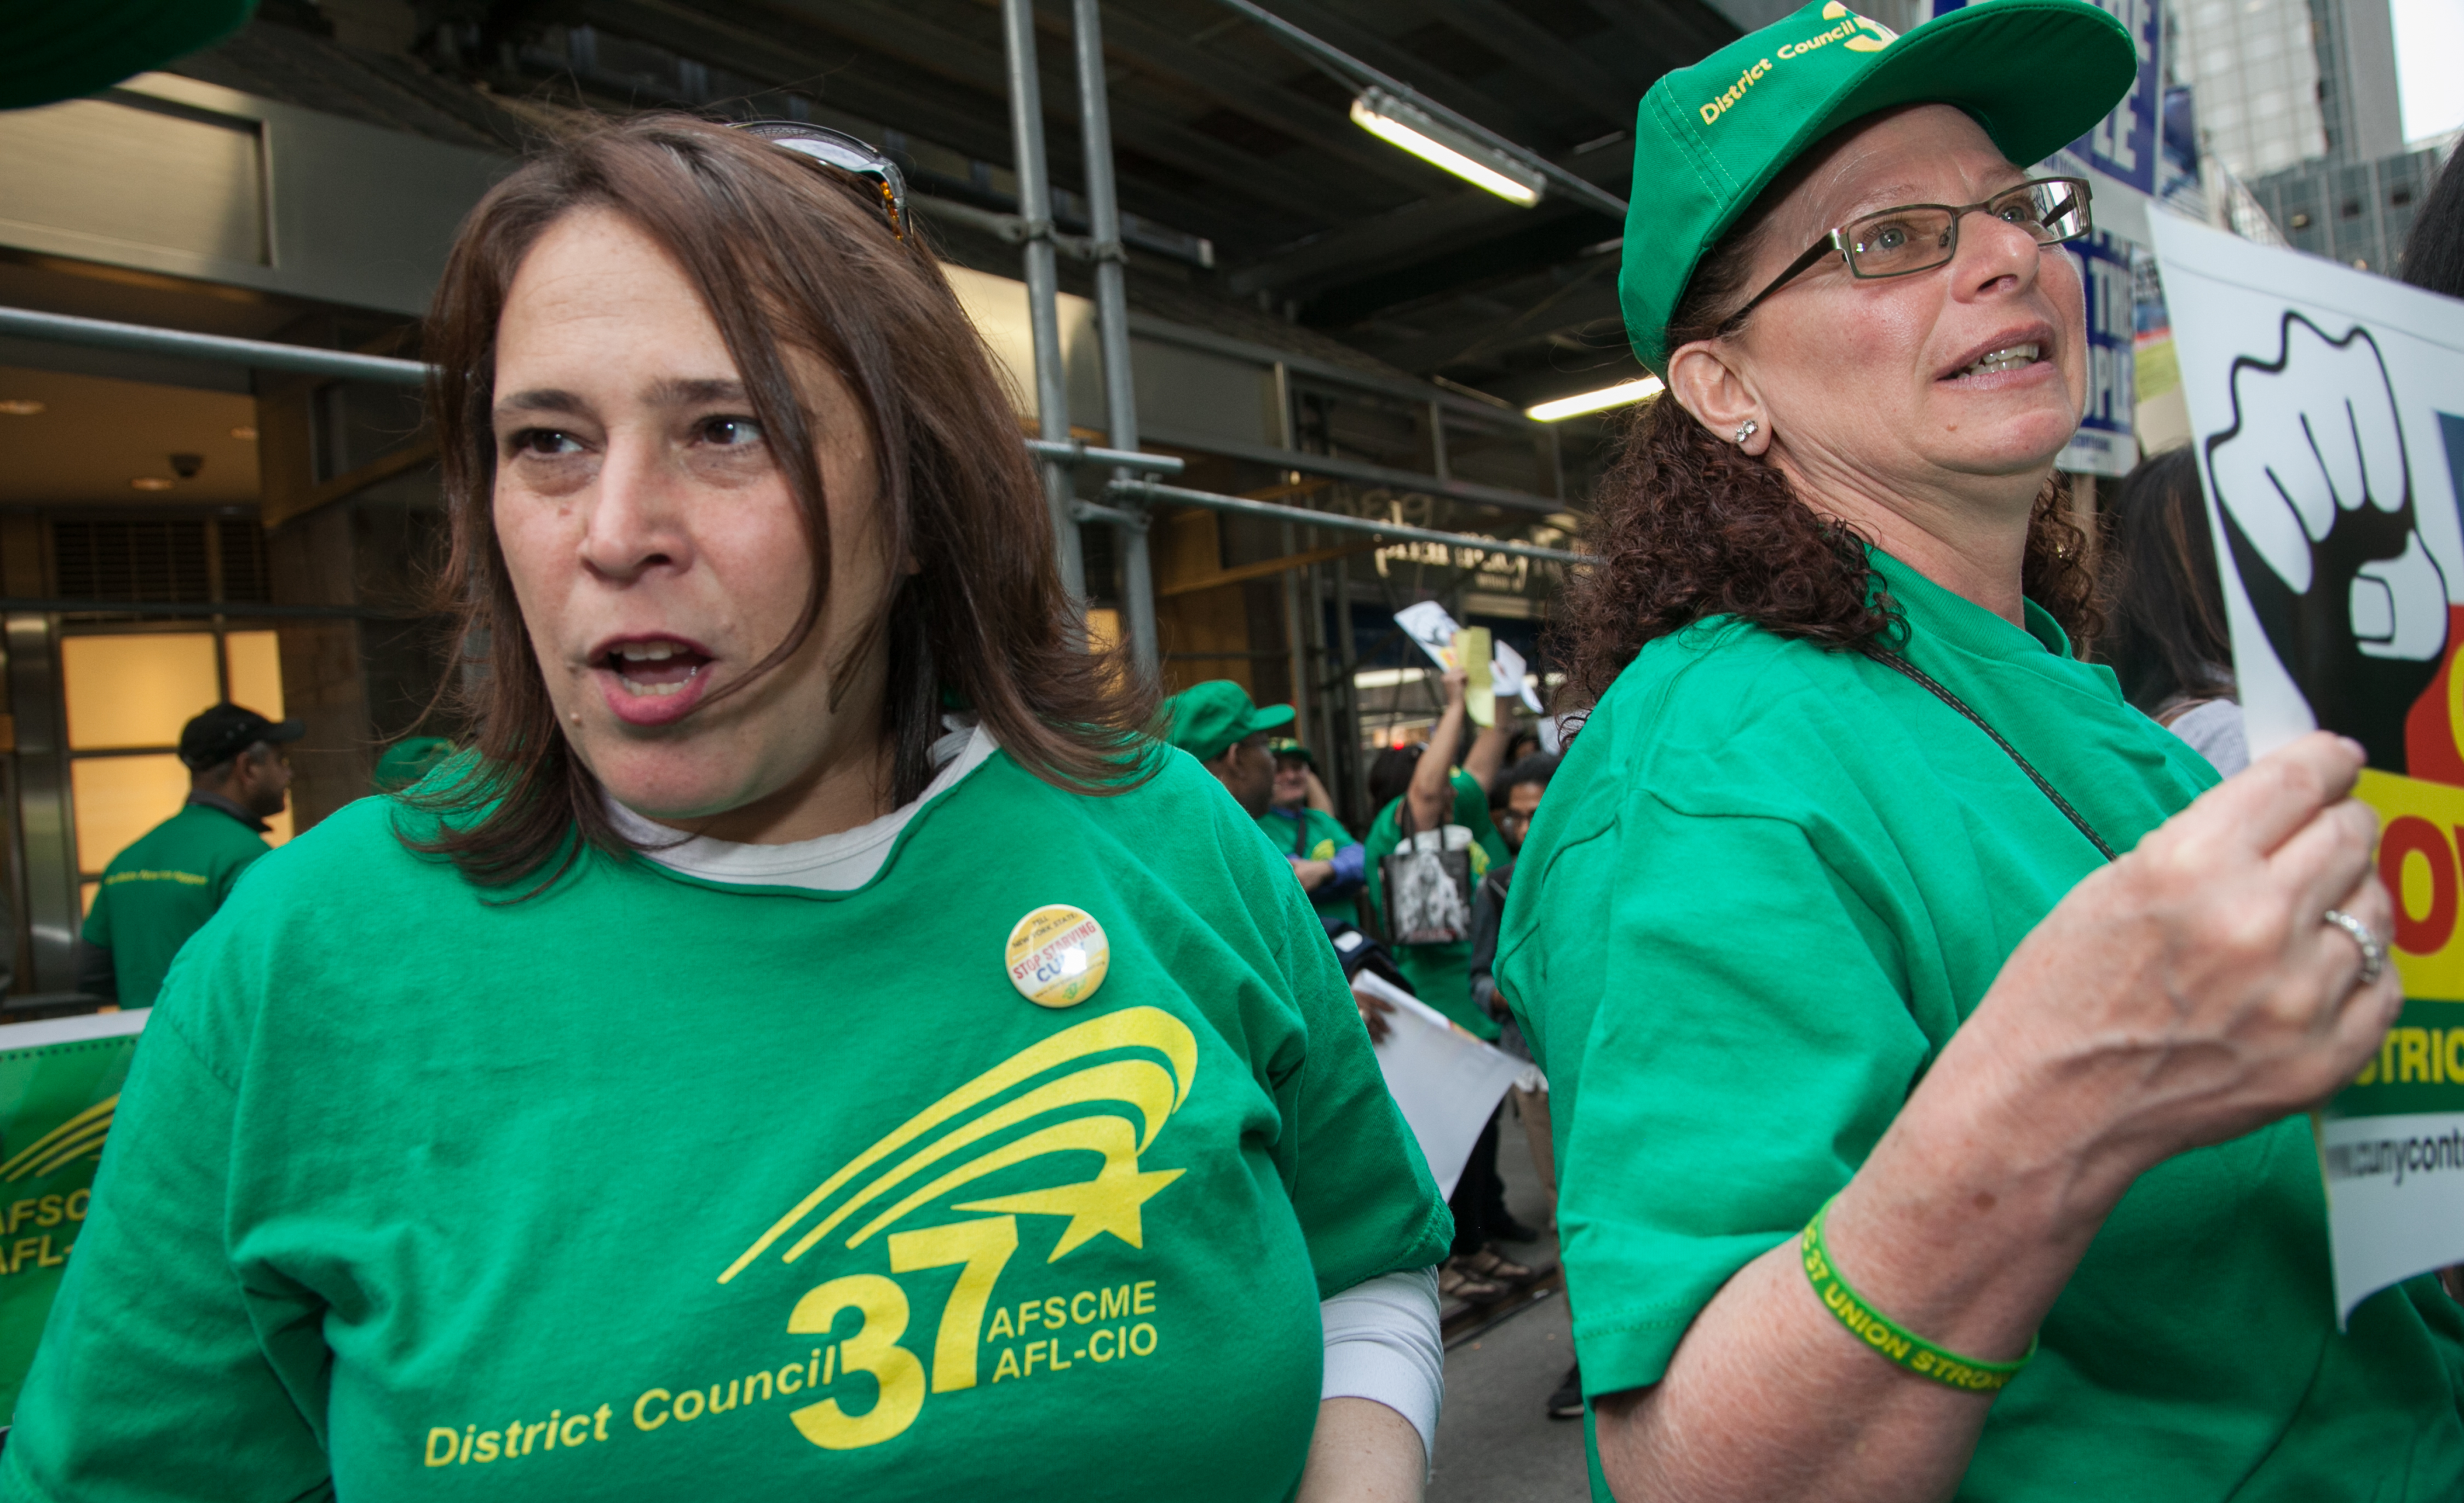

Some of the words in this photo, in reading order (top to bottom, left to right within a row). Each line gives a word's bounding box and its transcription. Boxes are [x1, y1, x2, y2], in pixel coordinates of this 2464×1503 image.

[1700, 58, 1773, 125] District
[1777, 19, 1857, 60] Council
[1012, 935, 1029, 948] NEW
[1033, 924, 1053, 938] YORK
[1013, 954, 1041, 980] STOP
[1043, 921, 1097, 960] STARVING
[2356, 1025, 2464, 1086] TRIC
[0, 1188, 91, 1236] FSC
[424, 1402, 613, 1467] District
[632, 1345, 837, 1431] Council
[786, 1214, 1020, 1450] 37
[986, 1280, 1156, 1343] AFSCME
[1823, 1281, 1912, 1360] UNION
[1911, 1350, 2004, 1390] STRO
[992, 1322, 1158, 1384] AFL-CIO
